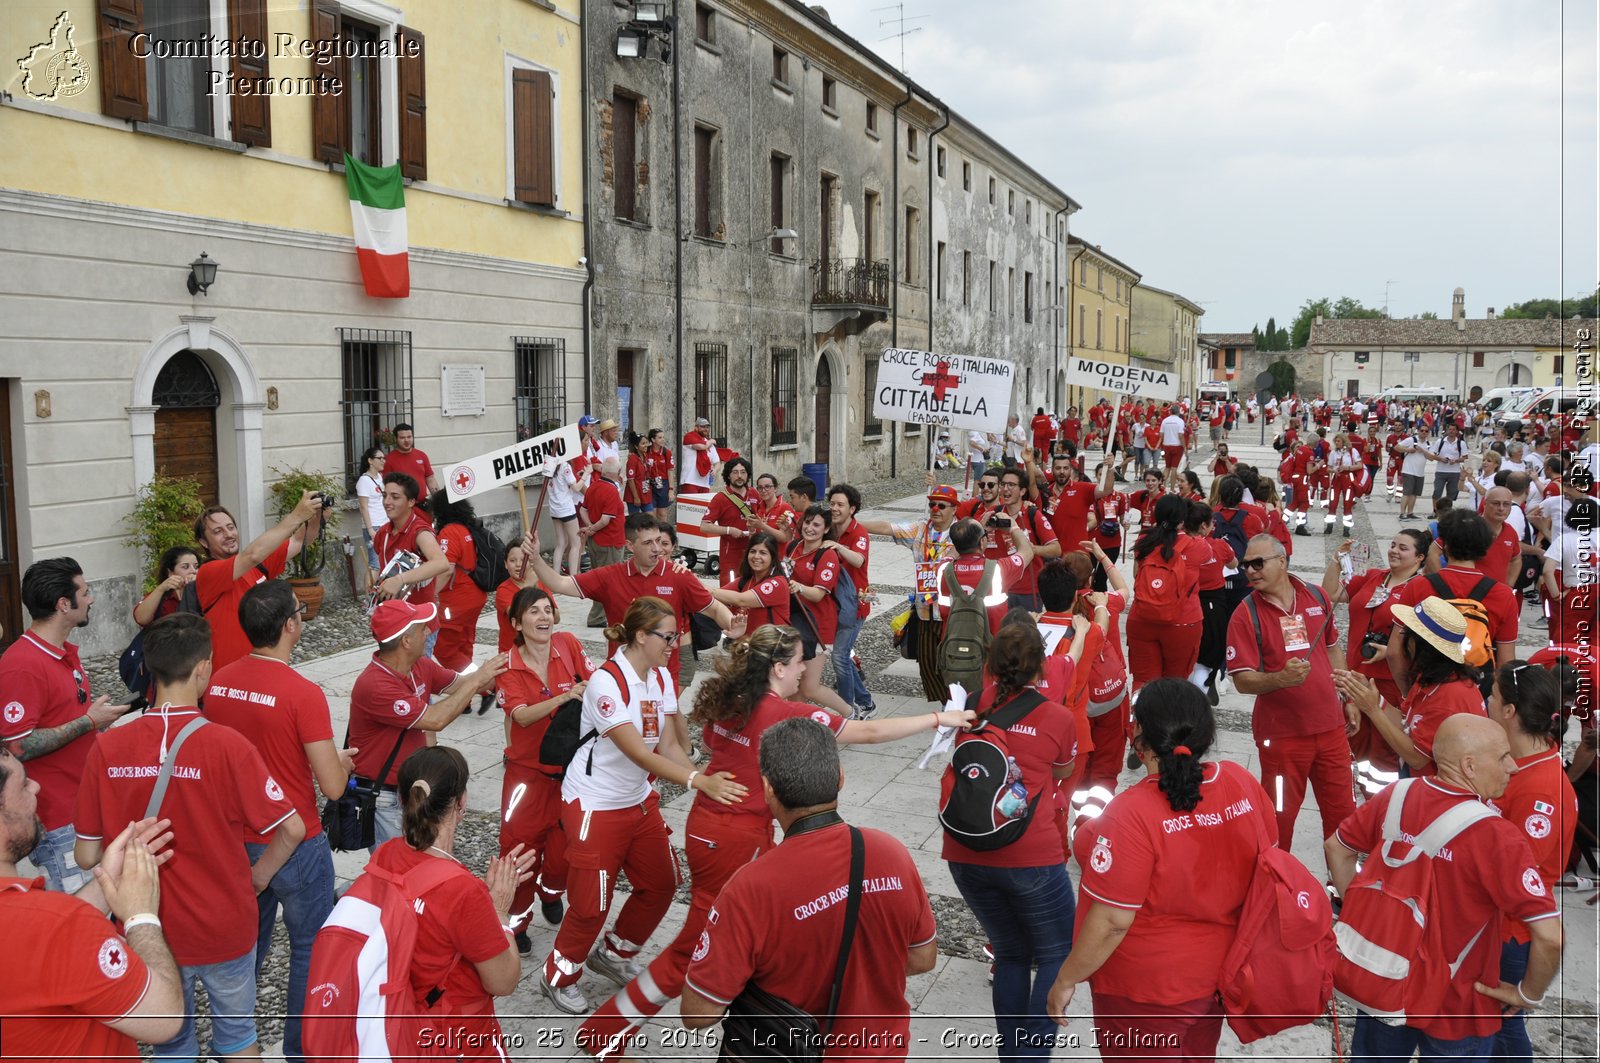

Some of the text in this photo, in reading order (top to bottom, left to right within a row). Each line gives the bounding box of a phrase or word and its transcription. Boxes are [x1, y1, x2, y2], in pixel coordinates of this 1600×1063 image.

[882, 348, 1010, 377] CROCE ROSSA ITALIANA
[957, 373, 967, 385] di
[1078, 360, 1169, 386] MODENA
[1102, 376, 1141, 395] Italy
[879, 386, 988, 418] CITTADELLA
[907, 410, 954, 427] (PADOVA)
[209, 685, 276, 707] CROCE ROSSA ITALIANA
[1094, 678, 1122, 696] Emirates
[1007, 724, 1037, 737] ALIANA
[108, 767, 134, 778] CROCE
[1163, 797, 1254, 834] CROCE ROSSA ITALIANA
[794, 876, 903, 921] CROCE ROSS TALIANA
